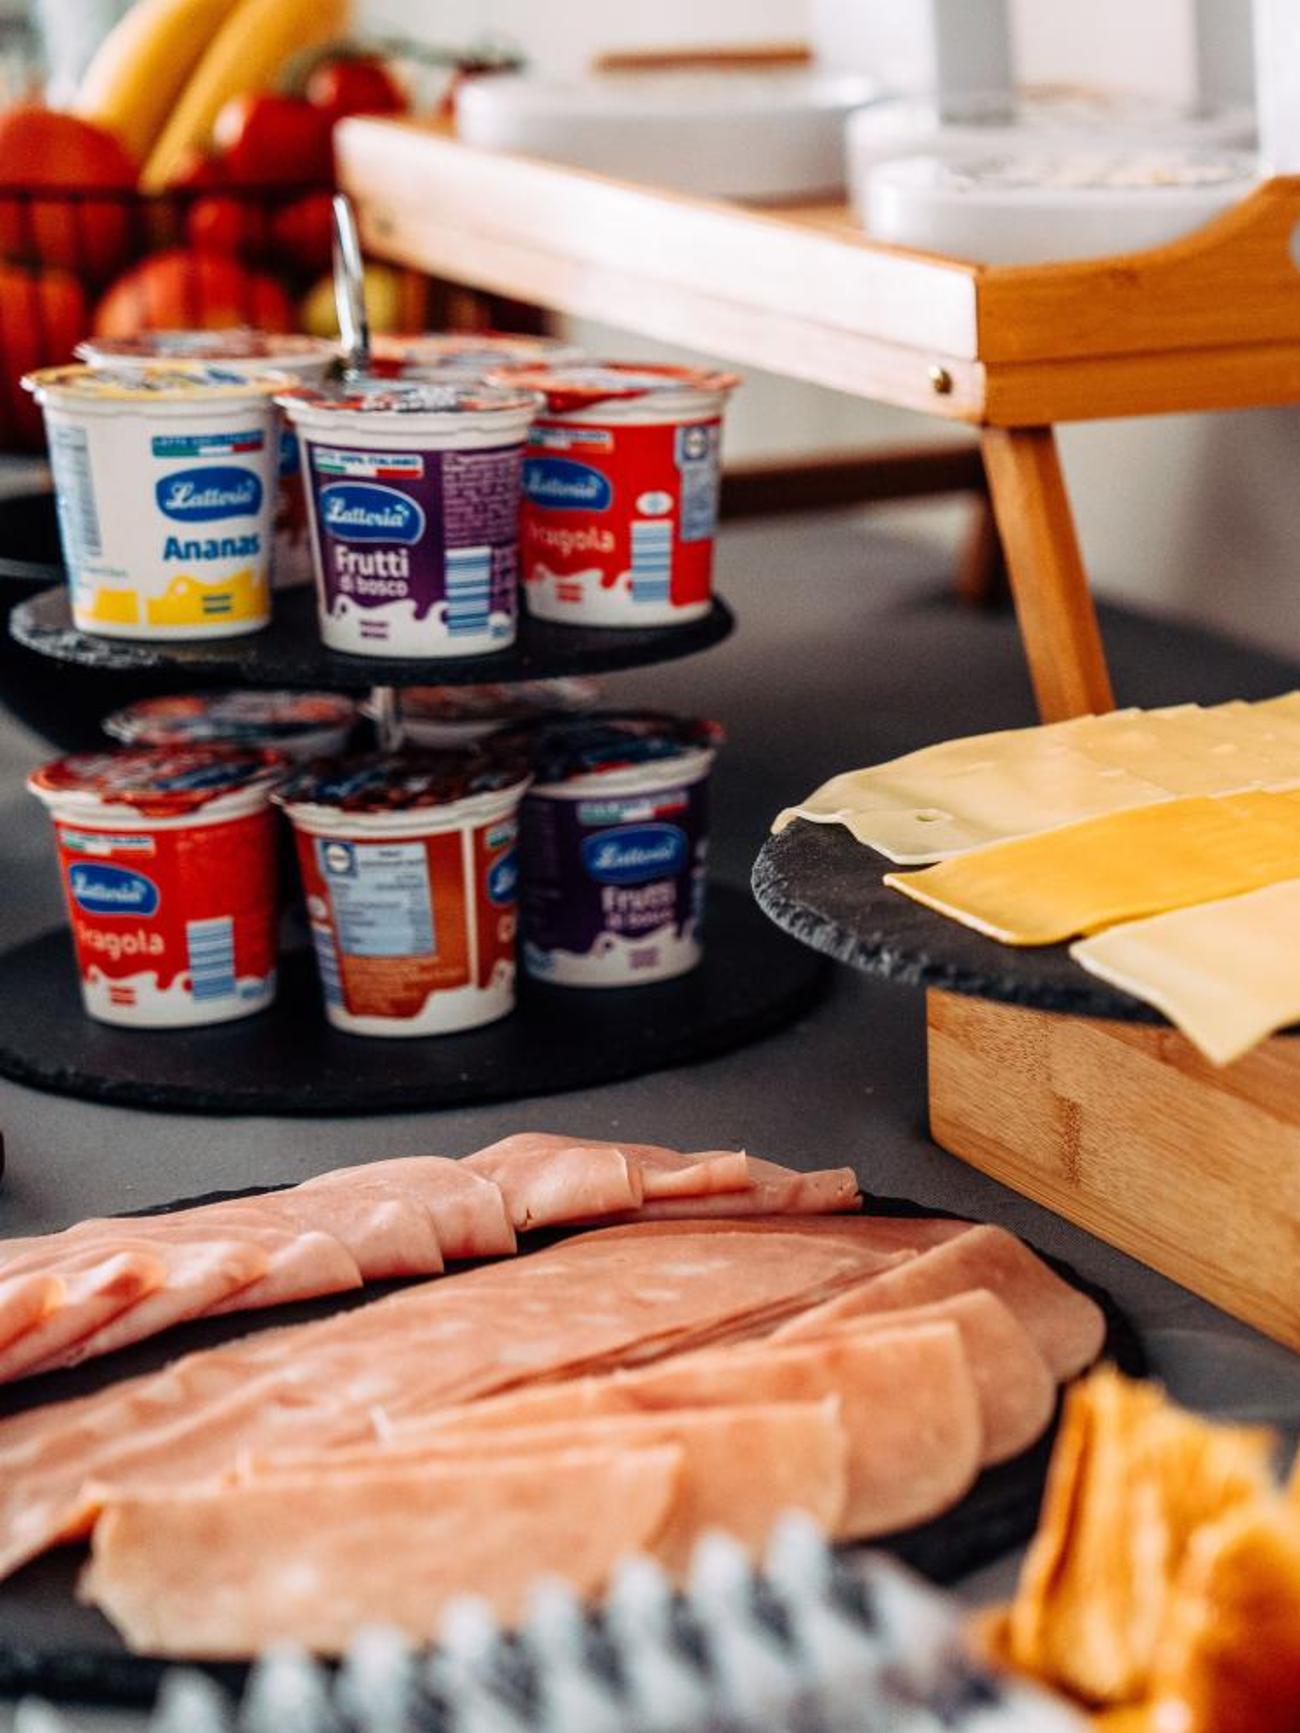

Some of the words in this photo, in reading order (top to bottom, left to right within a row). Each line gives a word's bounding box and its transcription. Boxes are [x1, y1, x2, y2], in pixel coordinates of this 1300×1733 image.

[163, 532, 261, 561] Ananas
[335, 545, 409, 578] Frutti
[357, 576, 409, 598] bosco
